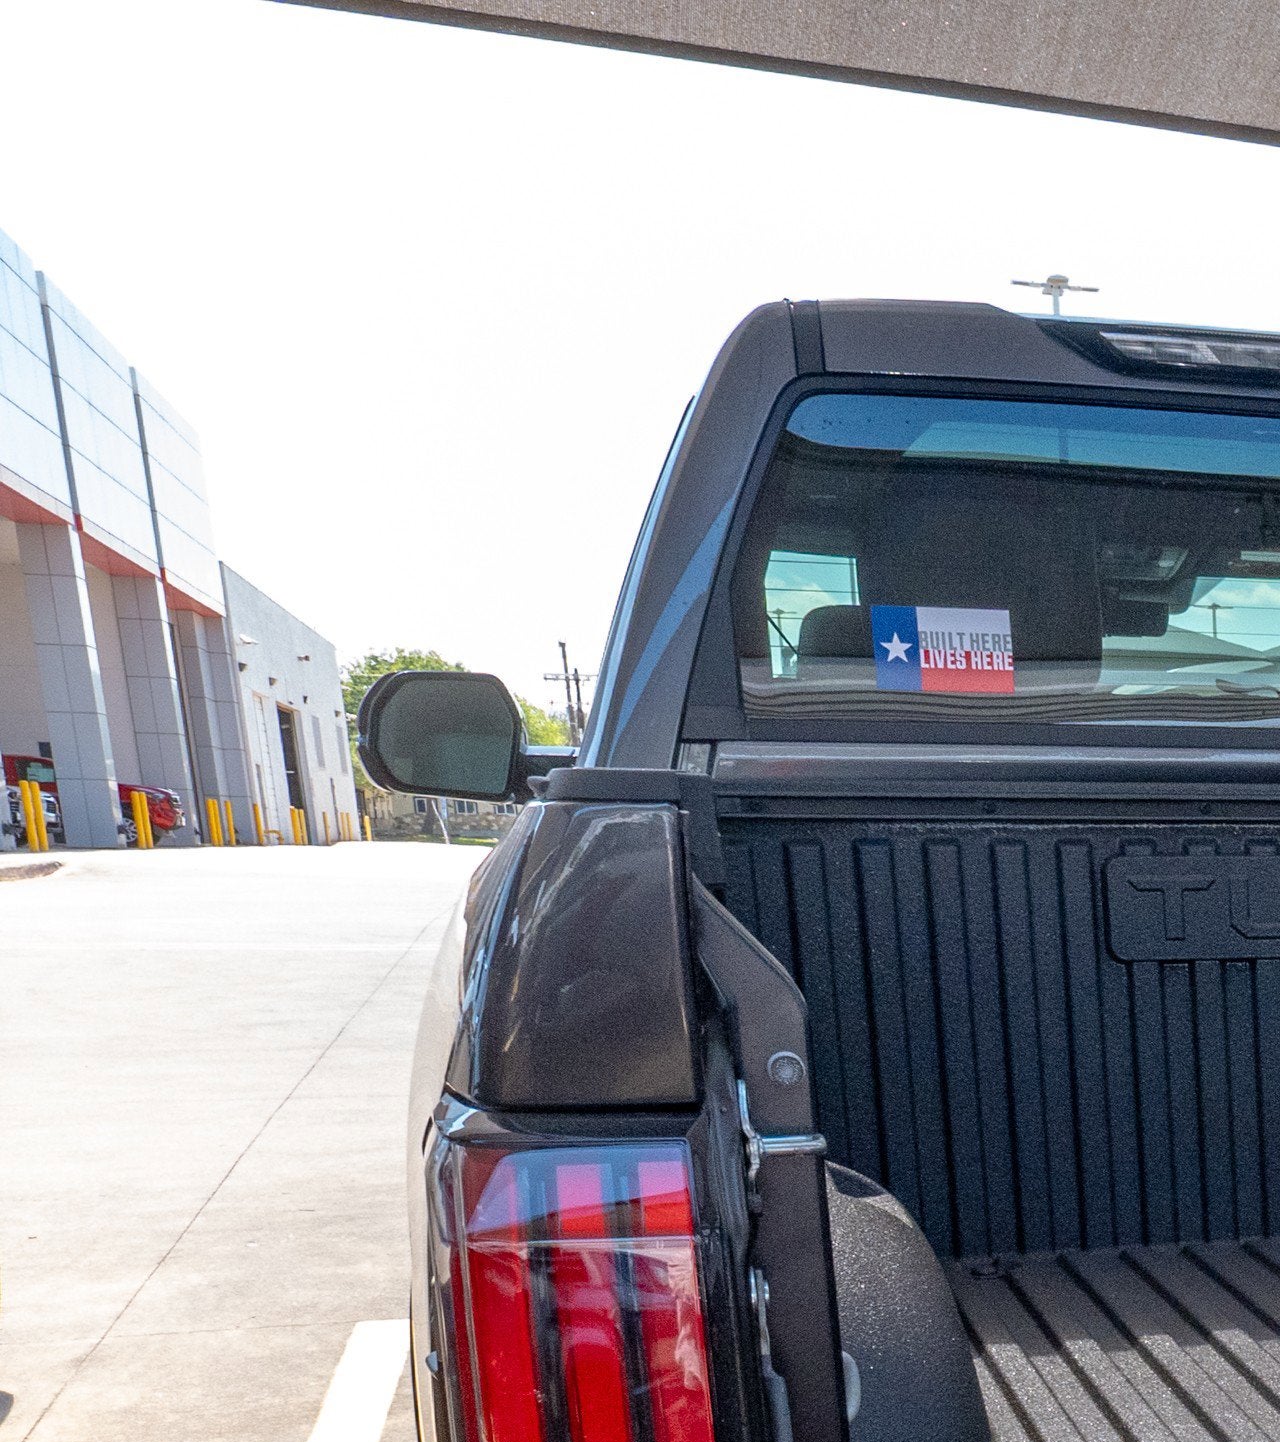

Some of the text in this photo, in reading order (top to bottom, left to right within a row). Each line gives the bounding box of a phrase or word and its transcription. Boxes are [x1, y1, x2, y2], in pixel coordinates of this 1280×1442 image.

[918, 630, 1012, 651] BUILT HERE
[920, 650, 1014, 671] LIVES HERE
